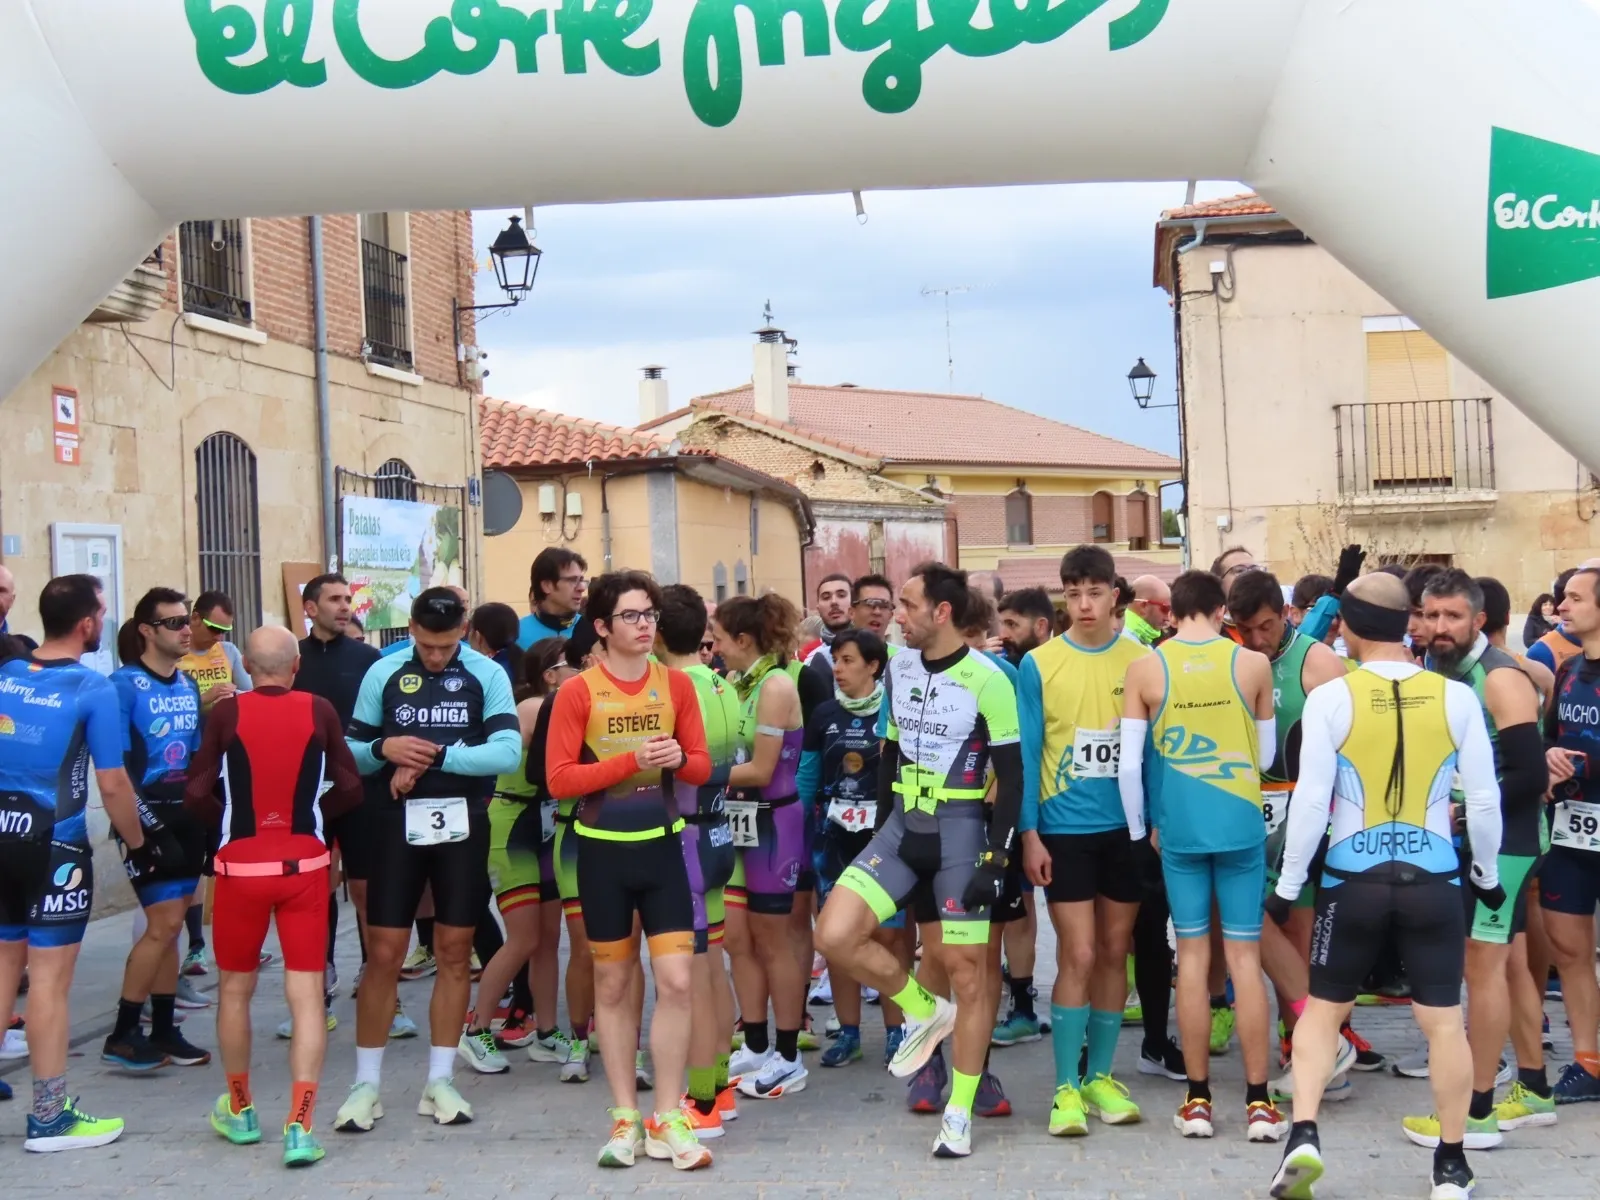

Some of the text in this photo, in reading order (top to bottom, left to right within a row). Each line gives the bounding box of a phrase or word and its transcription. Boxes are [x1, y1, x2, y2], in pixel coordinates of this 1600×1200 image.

[1493, 192, 1530, 230] El
[348, 507, 381, 537] Patatas
[23, 696, 62, 708] GARDEN
[149, 694, 198, 714] CÁCERES
[173, 713, 198, 731] MSC
[608, 712, 661, 734] ESTÉVEZ
[1558, 703, 1599, 725] NACHO
[1081, 743, 1120, 764] 103
[431, 811, 446, 830] 3
[842, 807, 868, 825] 41
[1569, 814, 1598, 836] 59
[1351, 830, 1433, 857] GURREA
[43, 890, 89, 914] MSC
